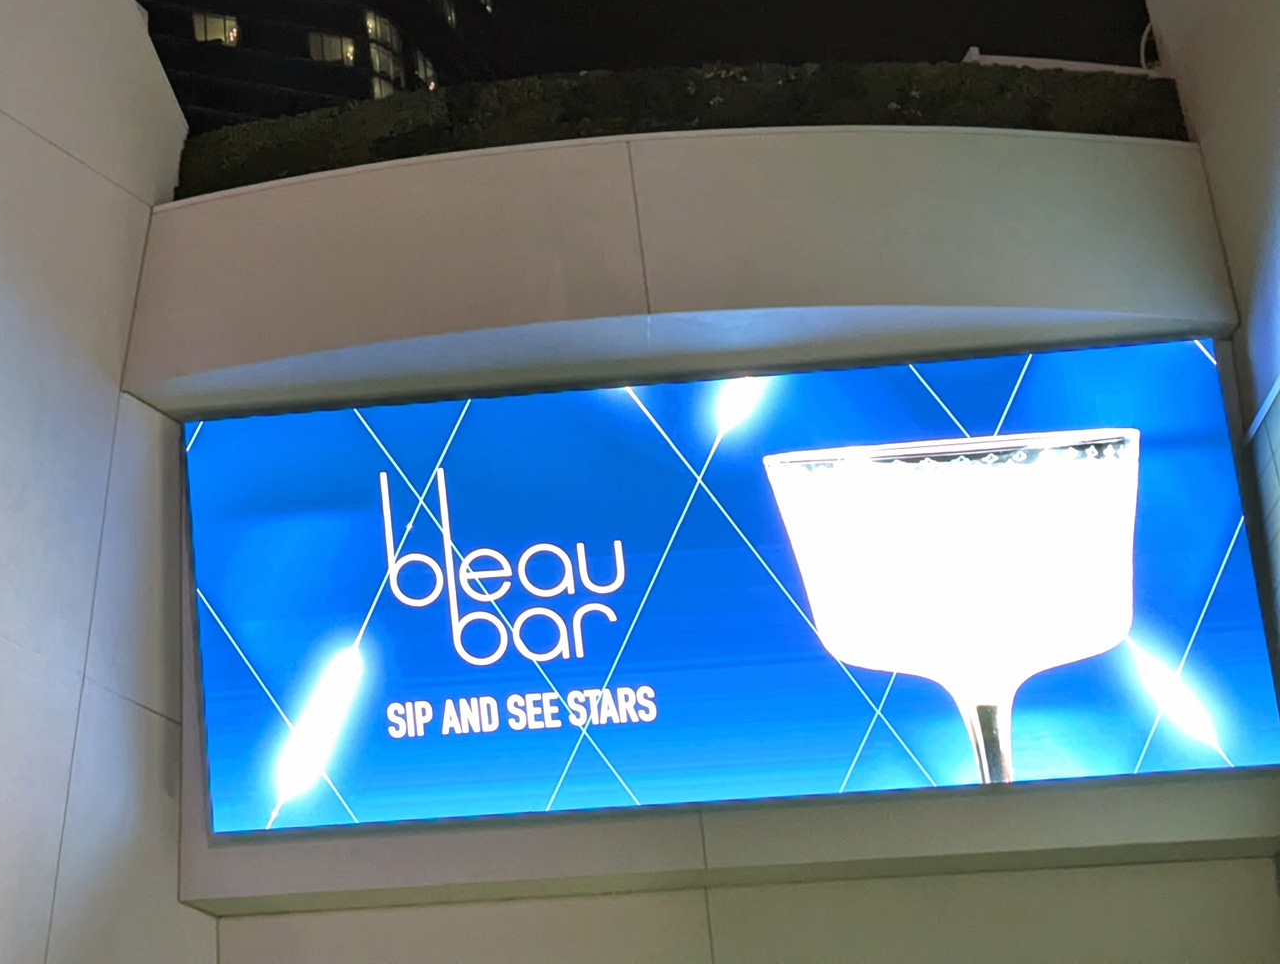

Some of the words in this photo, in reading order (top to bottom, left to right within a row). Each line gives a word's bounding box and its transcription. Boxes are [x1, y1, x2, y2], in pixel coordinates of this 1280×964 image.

[380, 467, 625, 607] bleau
[451, 602, 617, 666] bar
[386, 701, 433, 738] SIP
[442, 697, 500, 735] AND
[506, 692, 562, 731] SEE
[567, 685, 658, 727] STARS
